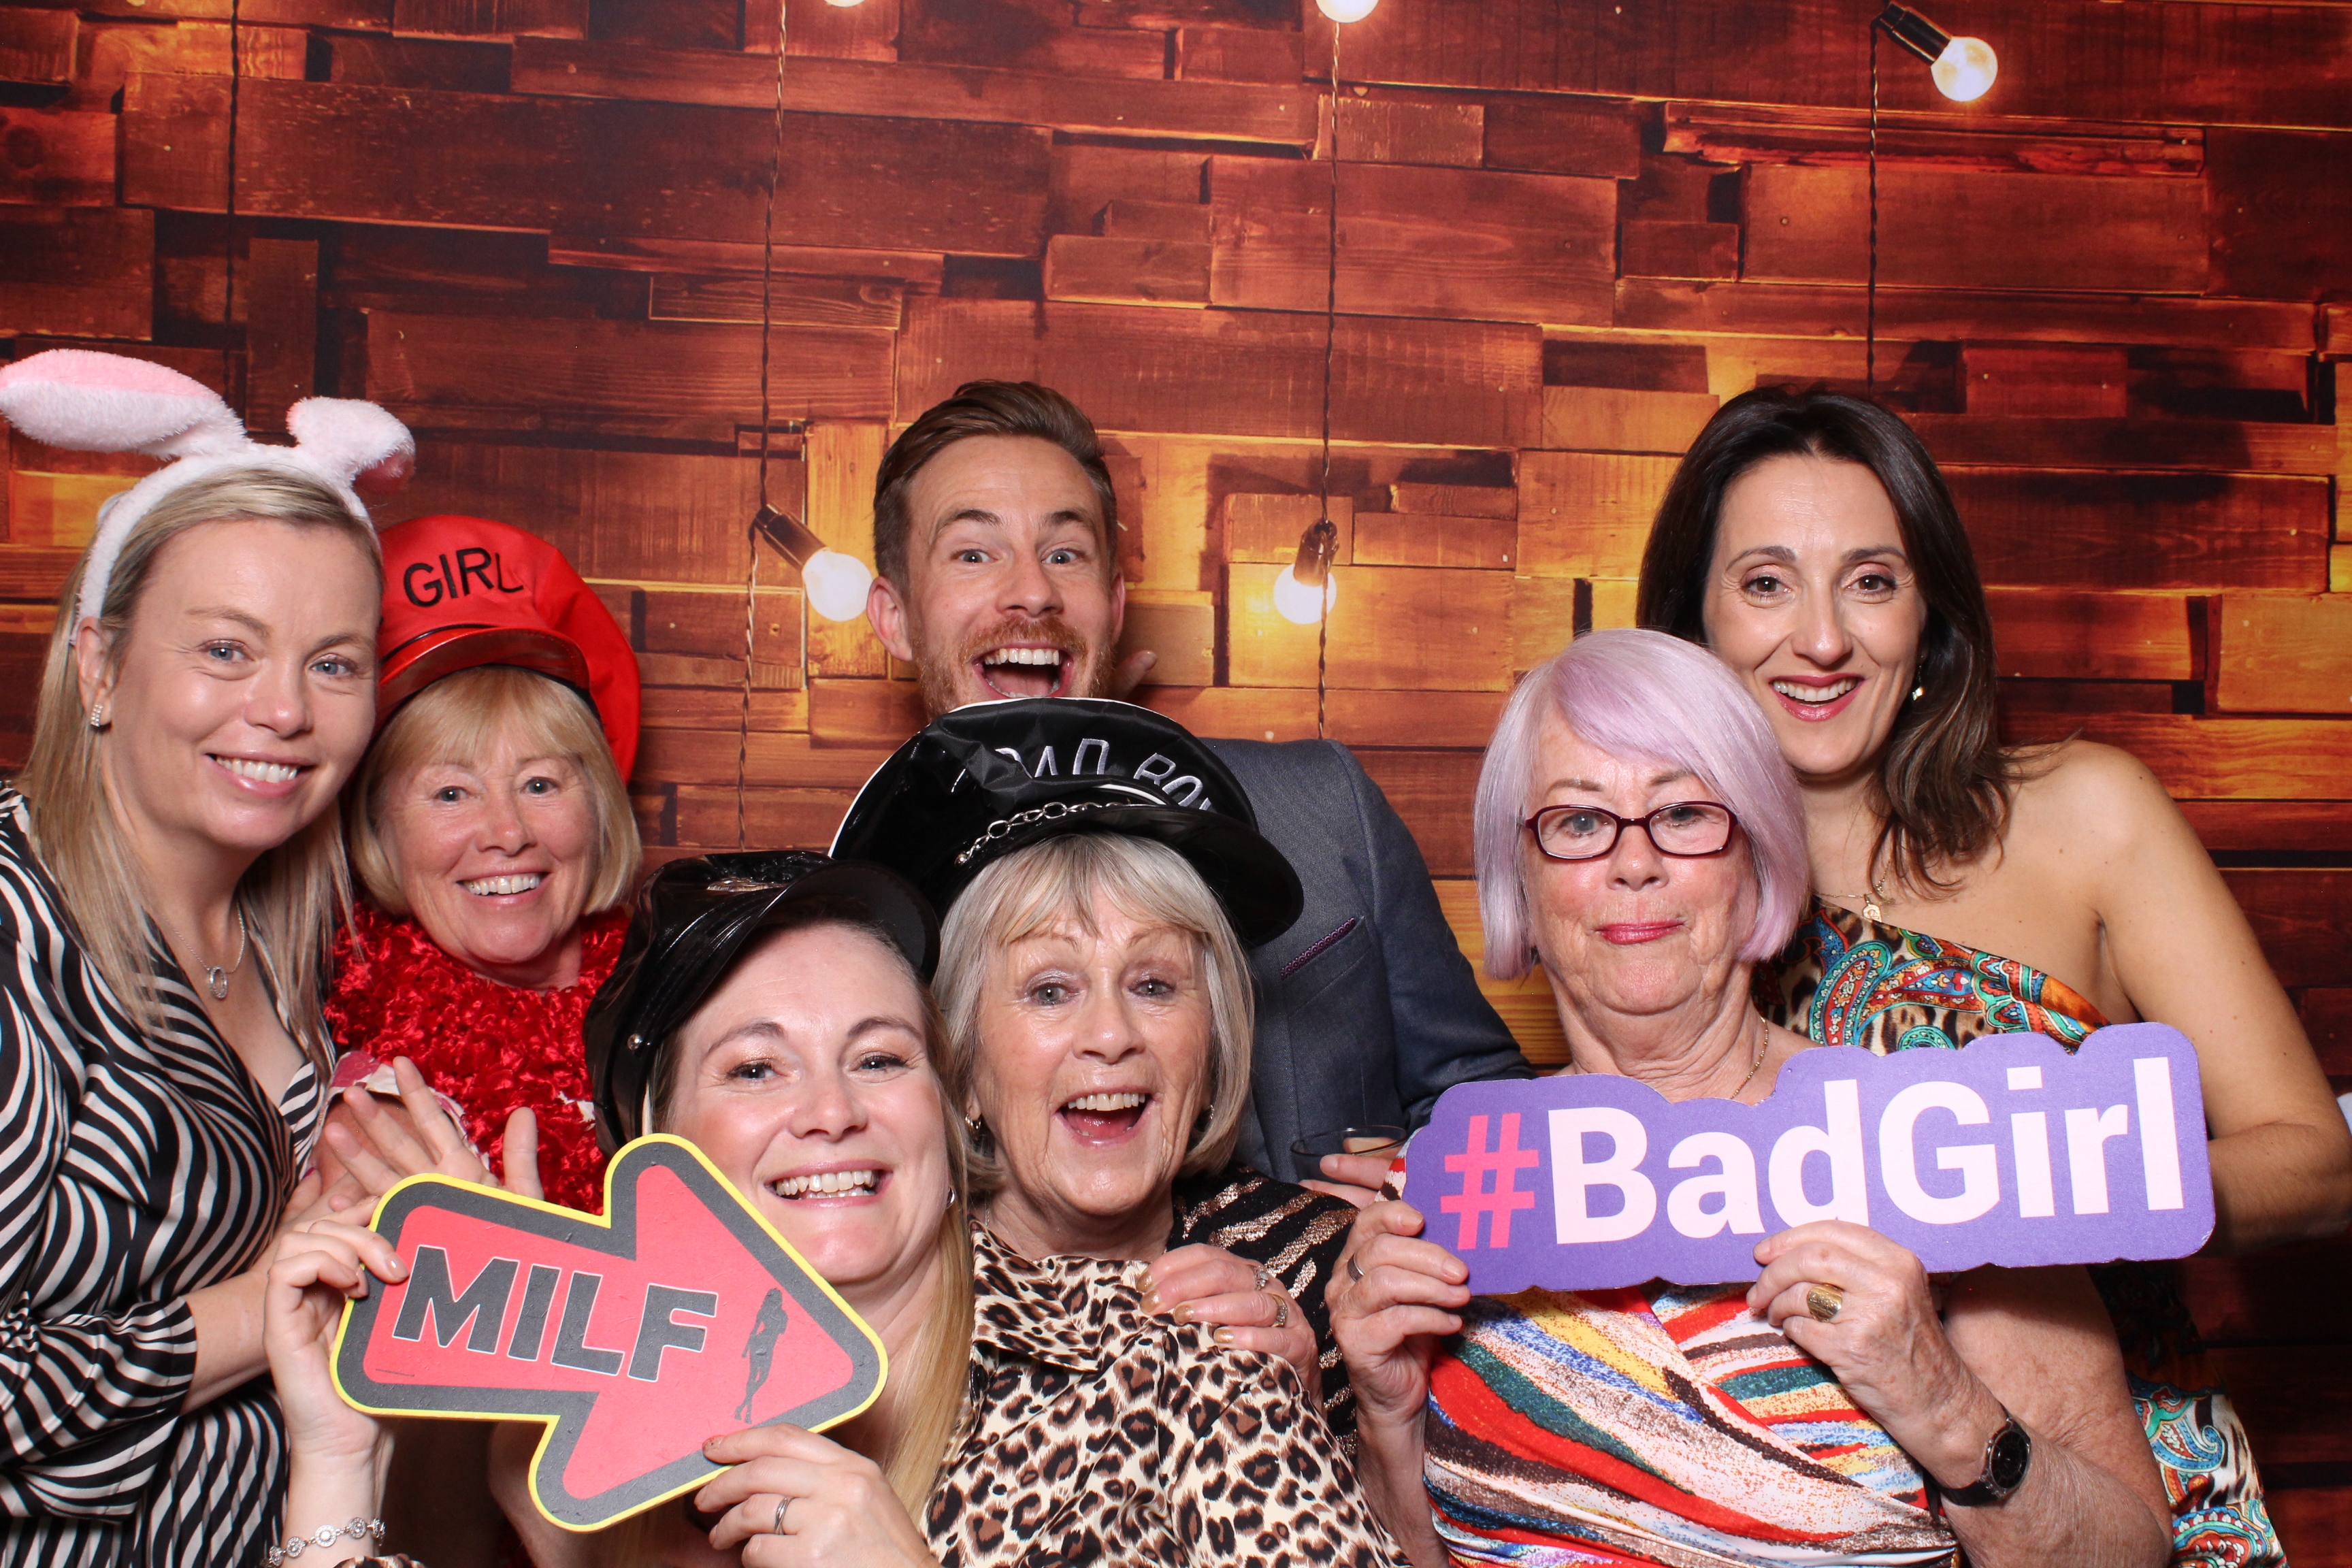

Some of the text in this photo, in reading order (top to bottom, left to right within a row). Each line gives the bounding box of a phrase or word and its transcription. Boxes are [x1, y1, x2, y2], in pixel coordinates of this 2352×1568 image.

[404, 547, 523, 607] GIRL
[1133, 753, 1211, 809] BO
[1440, 1057, 2183, 1250] #BadGirl
[393, 1245, 718, 1382] MILF
